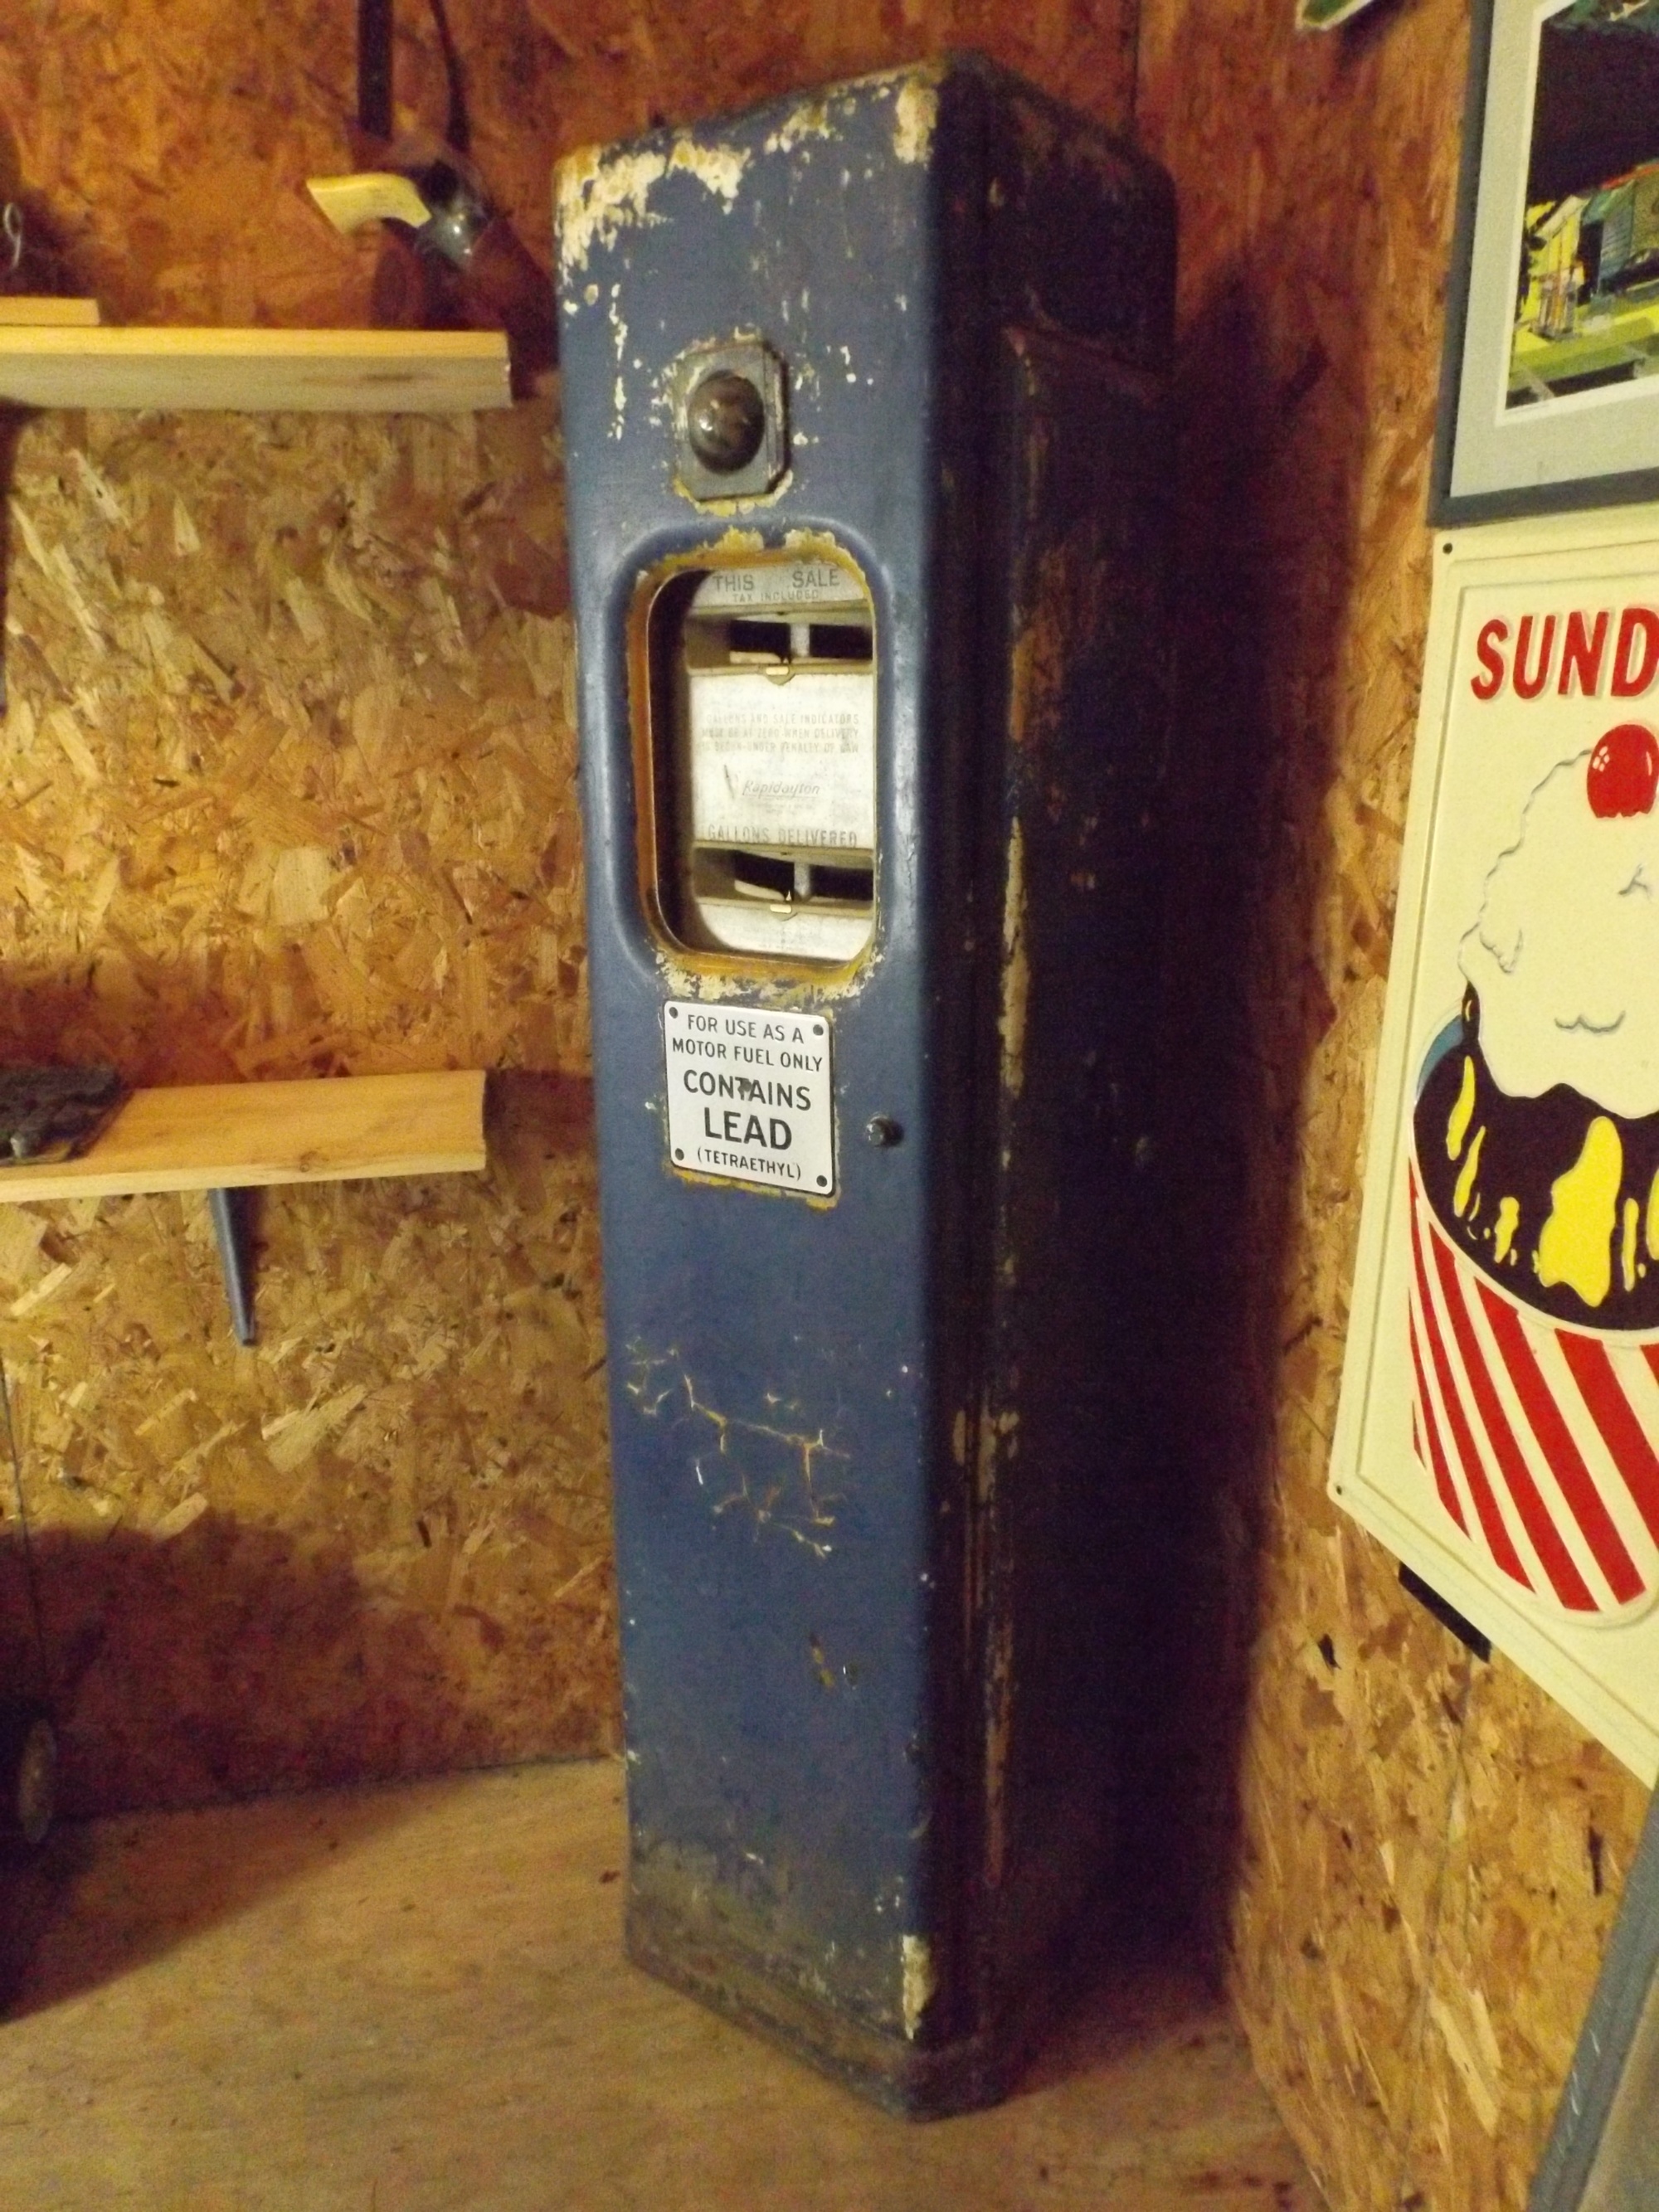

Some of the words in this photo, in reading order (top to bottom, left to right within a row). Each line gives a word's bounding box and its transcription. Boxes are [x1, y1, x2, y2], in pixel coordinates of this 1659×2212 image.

[713, 574, 755, 592] THIS
[791, 568, 840, 589] SALE
[732, 593, 753, 603] TAX
[761, 590, 819, 601] INCLUDED
[1470, 608, 1659, 700] SUND
[773, 714, 796, 724] SALE
[800, 714, 859, 725] INDICATORS
[814, 728, 859, 740] DELIVERY
[824, 742, 834, 753] OF
[742, 780, 820, 799] Rapidayton
[708, 824, 771, 843] GALLONS
[777, 827, 858, 847] DELIVERED
[688, 1014, 718, 1033] FOR
[725, 1018, 757, 1038] USE
[763, 1023, 785, 1042] AS
[792, 1028, 804, 1044] A
[672, 1038, 727, 1059] MOTOR
[734, 1046, 774, 1066] FUEL
[780, 1052, 823, 1072] ONLY
[684, 1069, 811, 1111] CONTAINS
[704, 1106, 792, 1150] LEAD
[697, 1146, 801, 1181] (TETRAETHYL)
